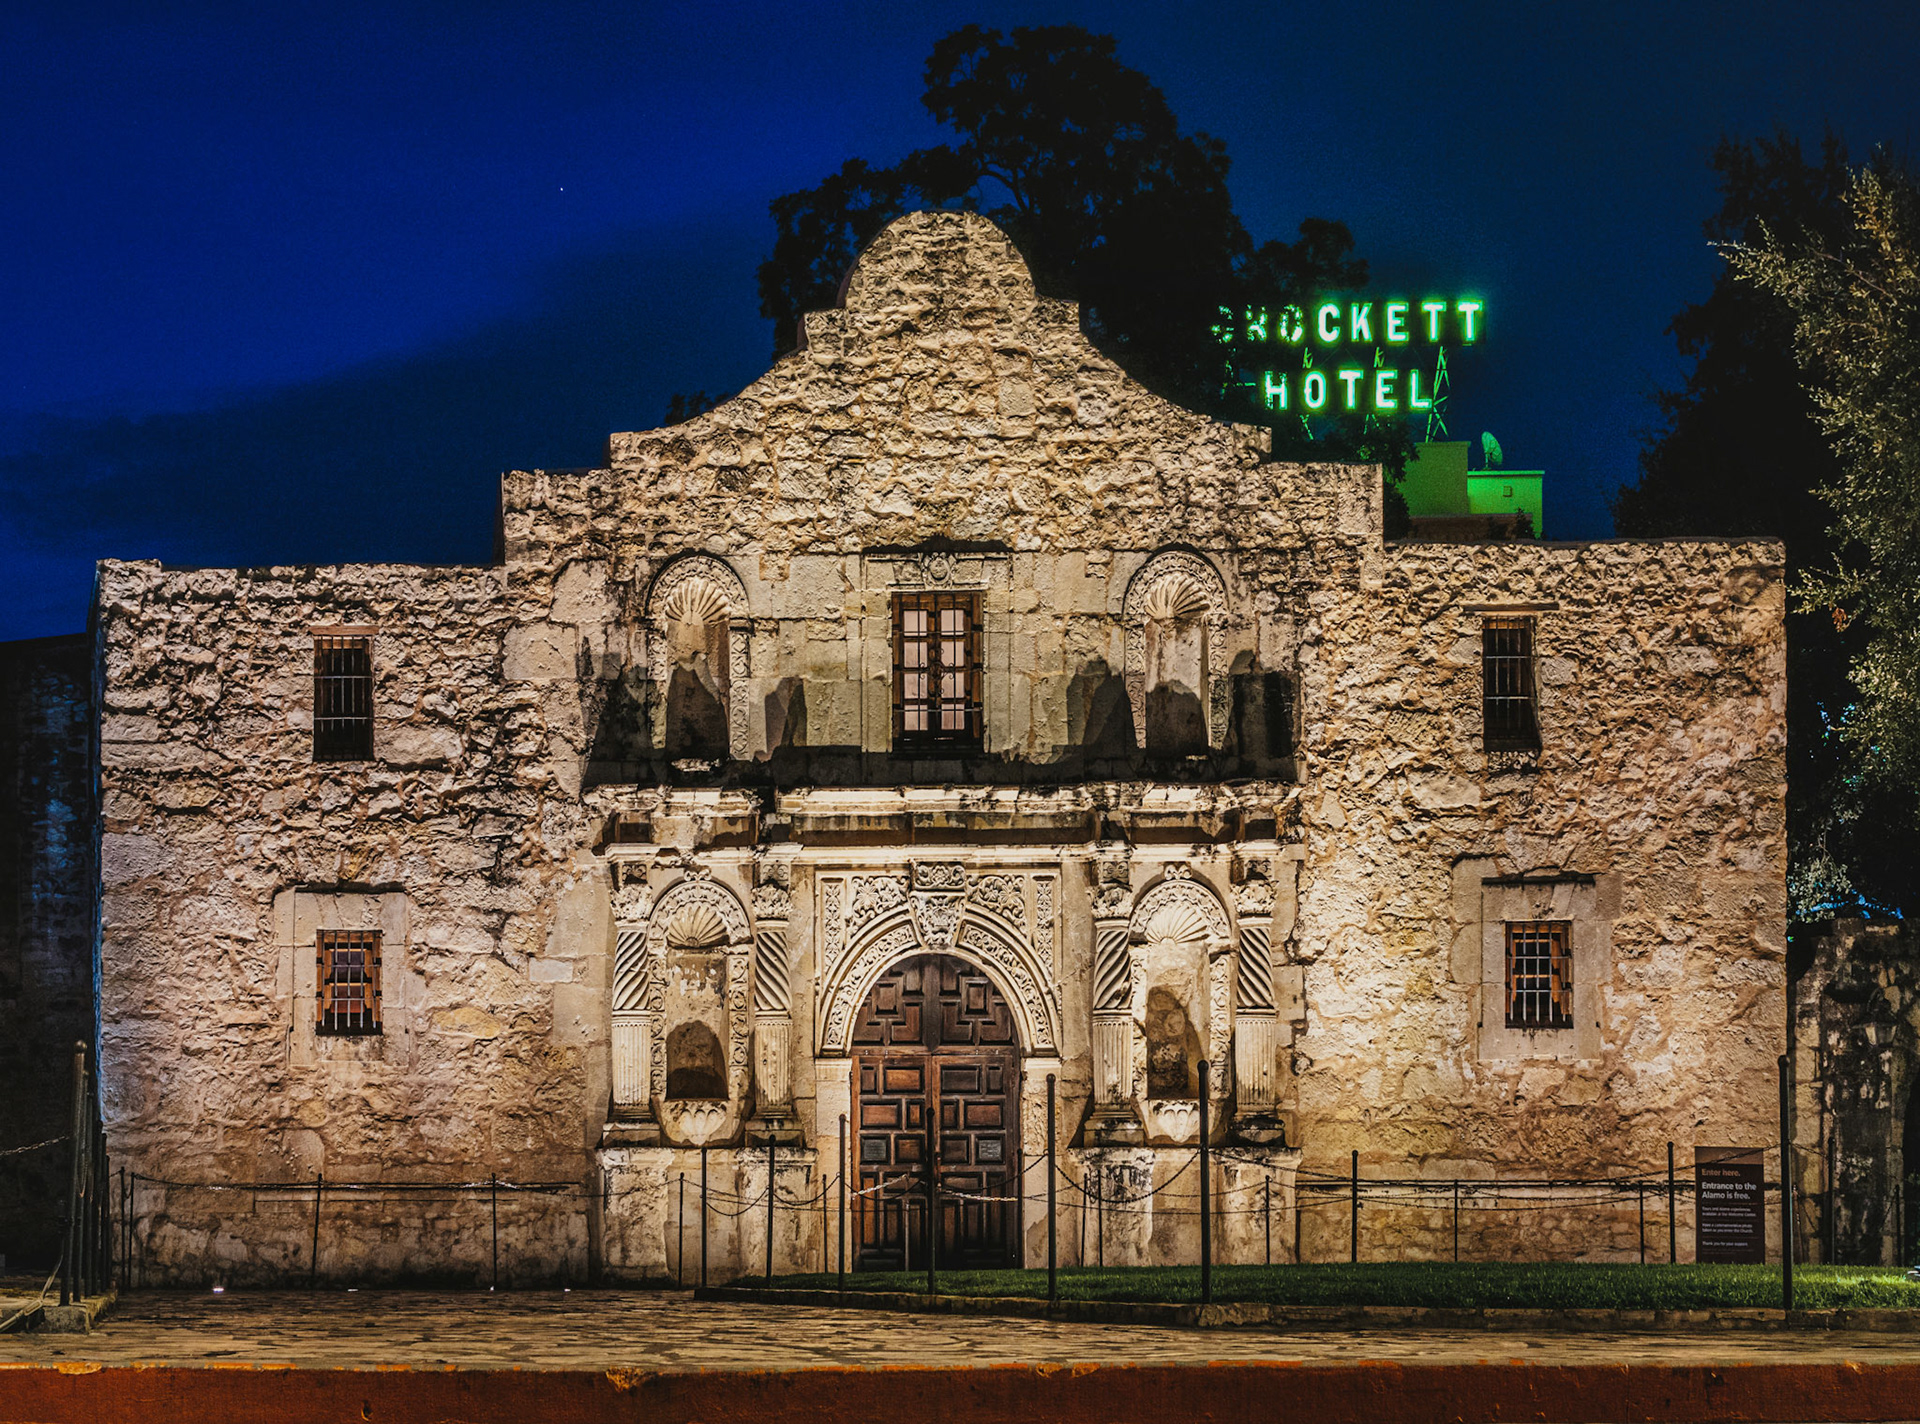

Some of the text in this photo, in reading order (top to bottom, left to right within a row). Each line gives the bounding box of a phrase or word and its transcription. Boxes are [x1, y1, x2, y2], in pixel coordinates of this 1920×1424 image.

[1264, 369, 1432, 410] HOTEL
[1702, 1168, 1720, 1176] Enter
[1702, 1182, 1734, 1190] Entrance
[1744, 1182, 1757, 1190] the
[1702, 1191, 1725, 1199] Alamo
[1726, 1191, 1733, 1199] is
